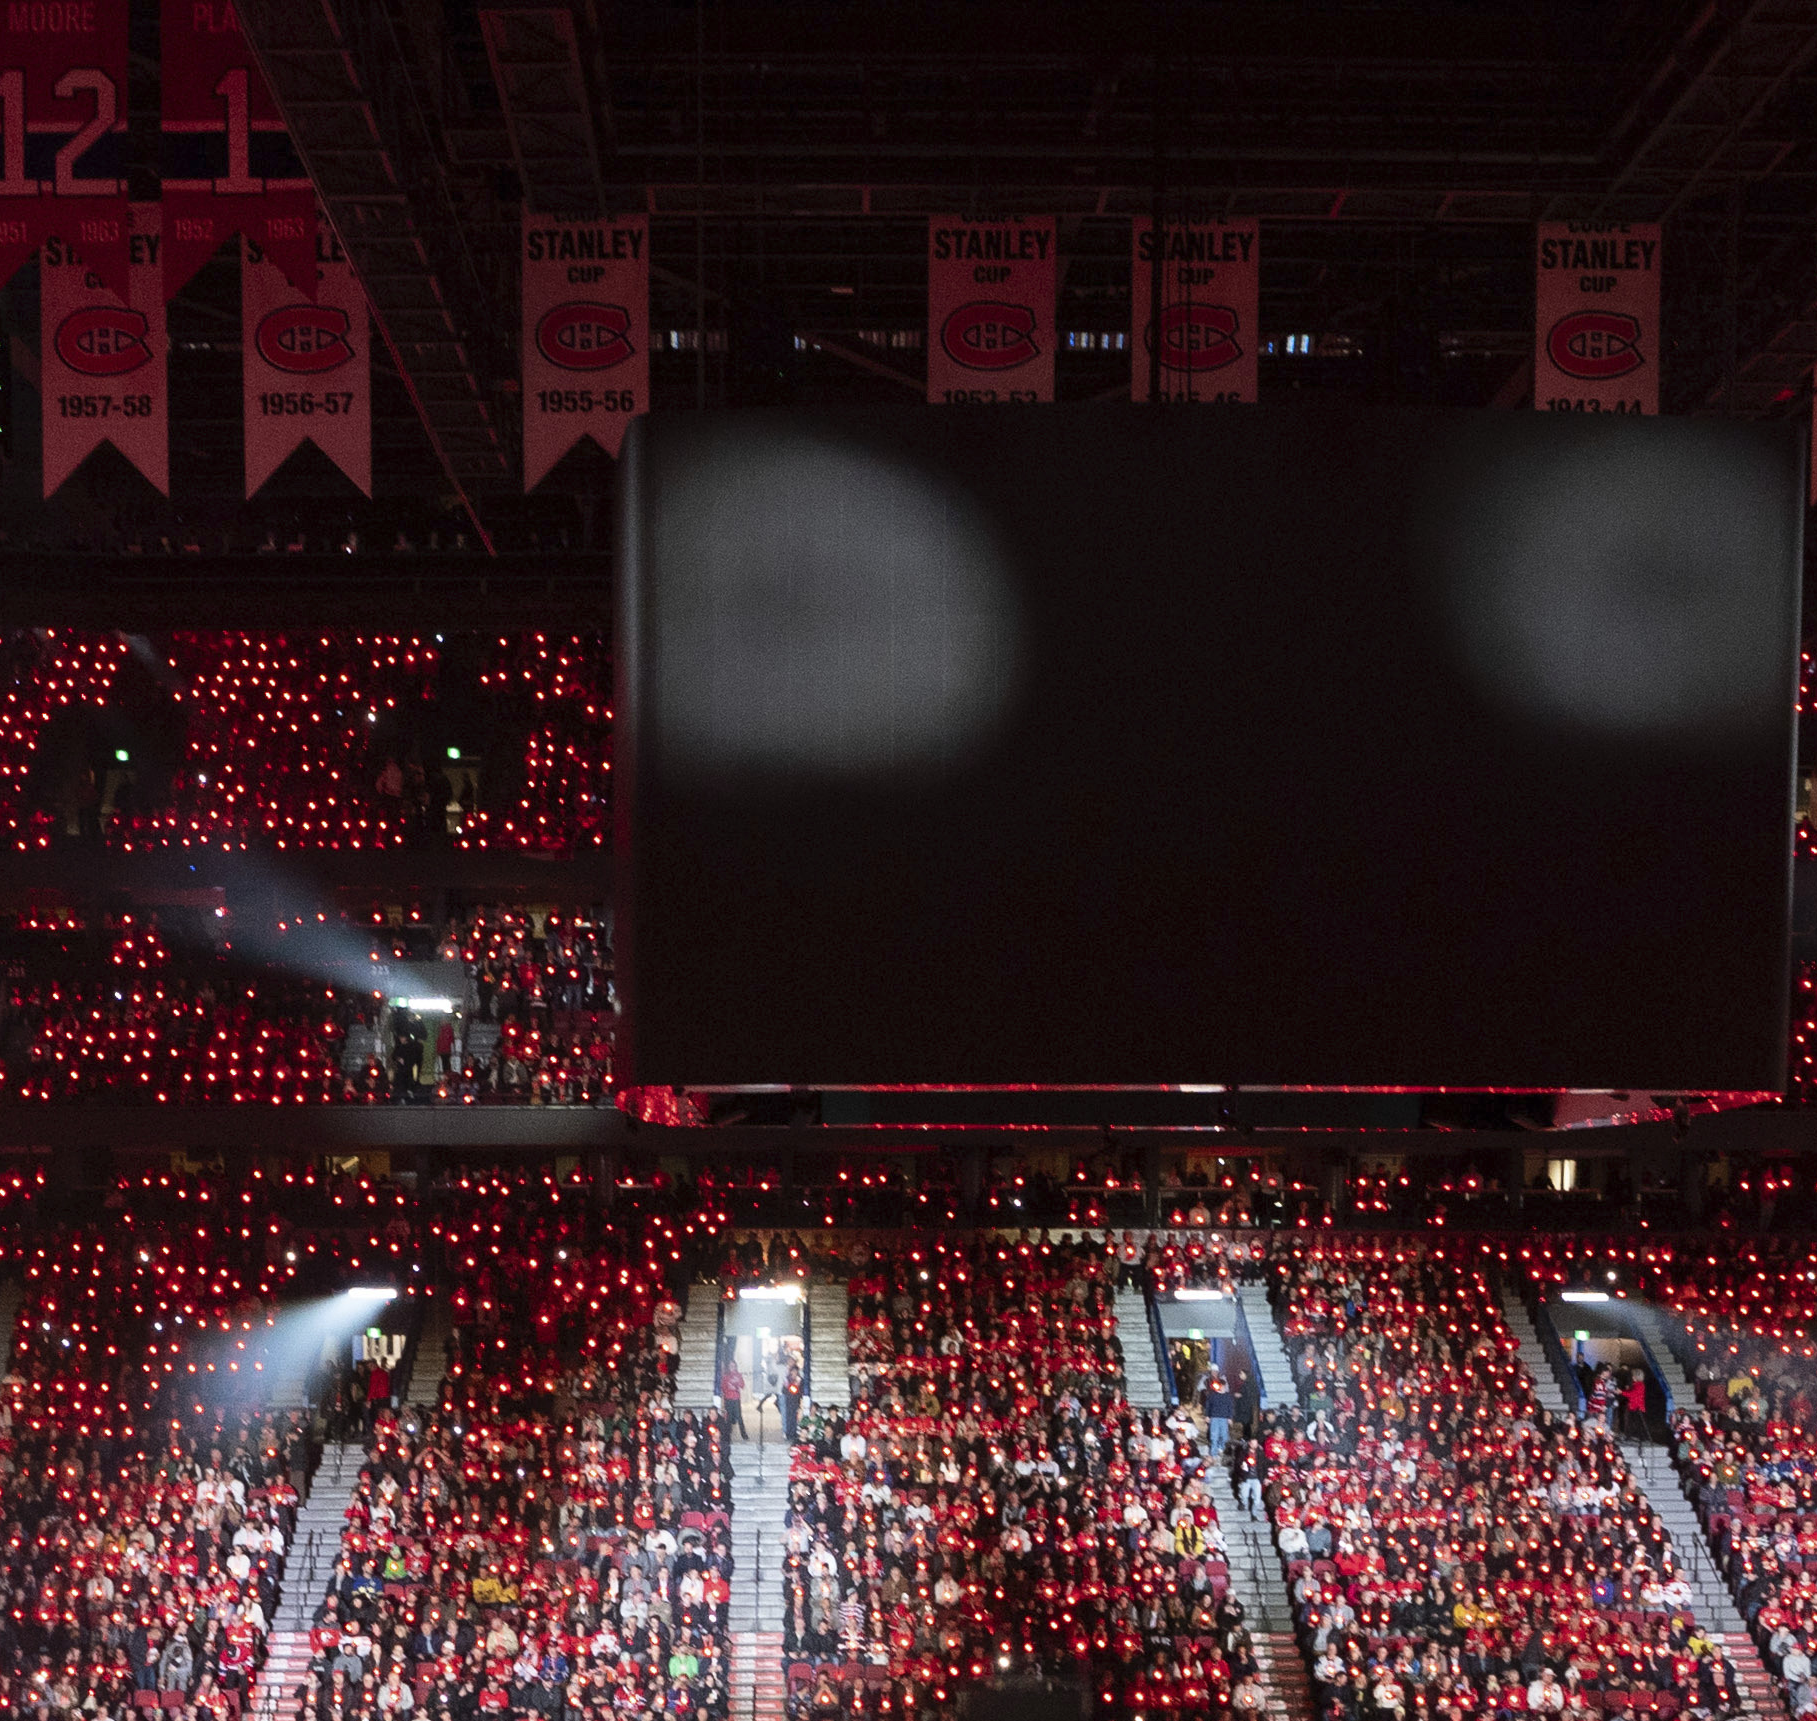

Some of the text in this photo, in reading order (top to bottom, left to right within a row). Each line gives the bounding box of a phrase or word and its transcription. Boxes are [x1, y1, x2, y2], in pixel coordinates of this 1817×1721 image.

[7, 1, 96, 35] MOORE
[212, 64, 265, 195] 1
[528, 229, 643, 262] STANLEY
[934, 229, 1051, 262] STANLEY
[1541, 239, 1656, 271] STANLEY
[567, 265, 605, 286] CUP
[972, 265, 1012, 286] CUP
[1579, 275, 1618, 295] CUP
[57, 396, 152, 418] 1957-58
[259, 393, 353, 416] 1956-57
[537, 390, 635, 413] 1955-56
